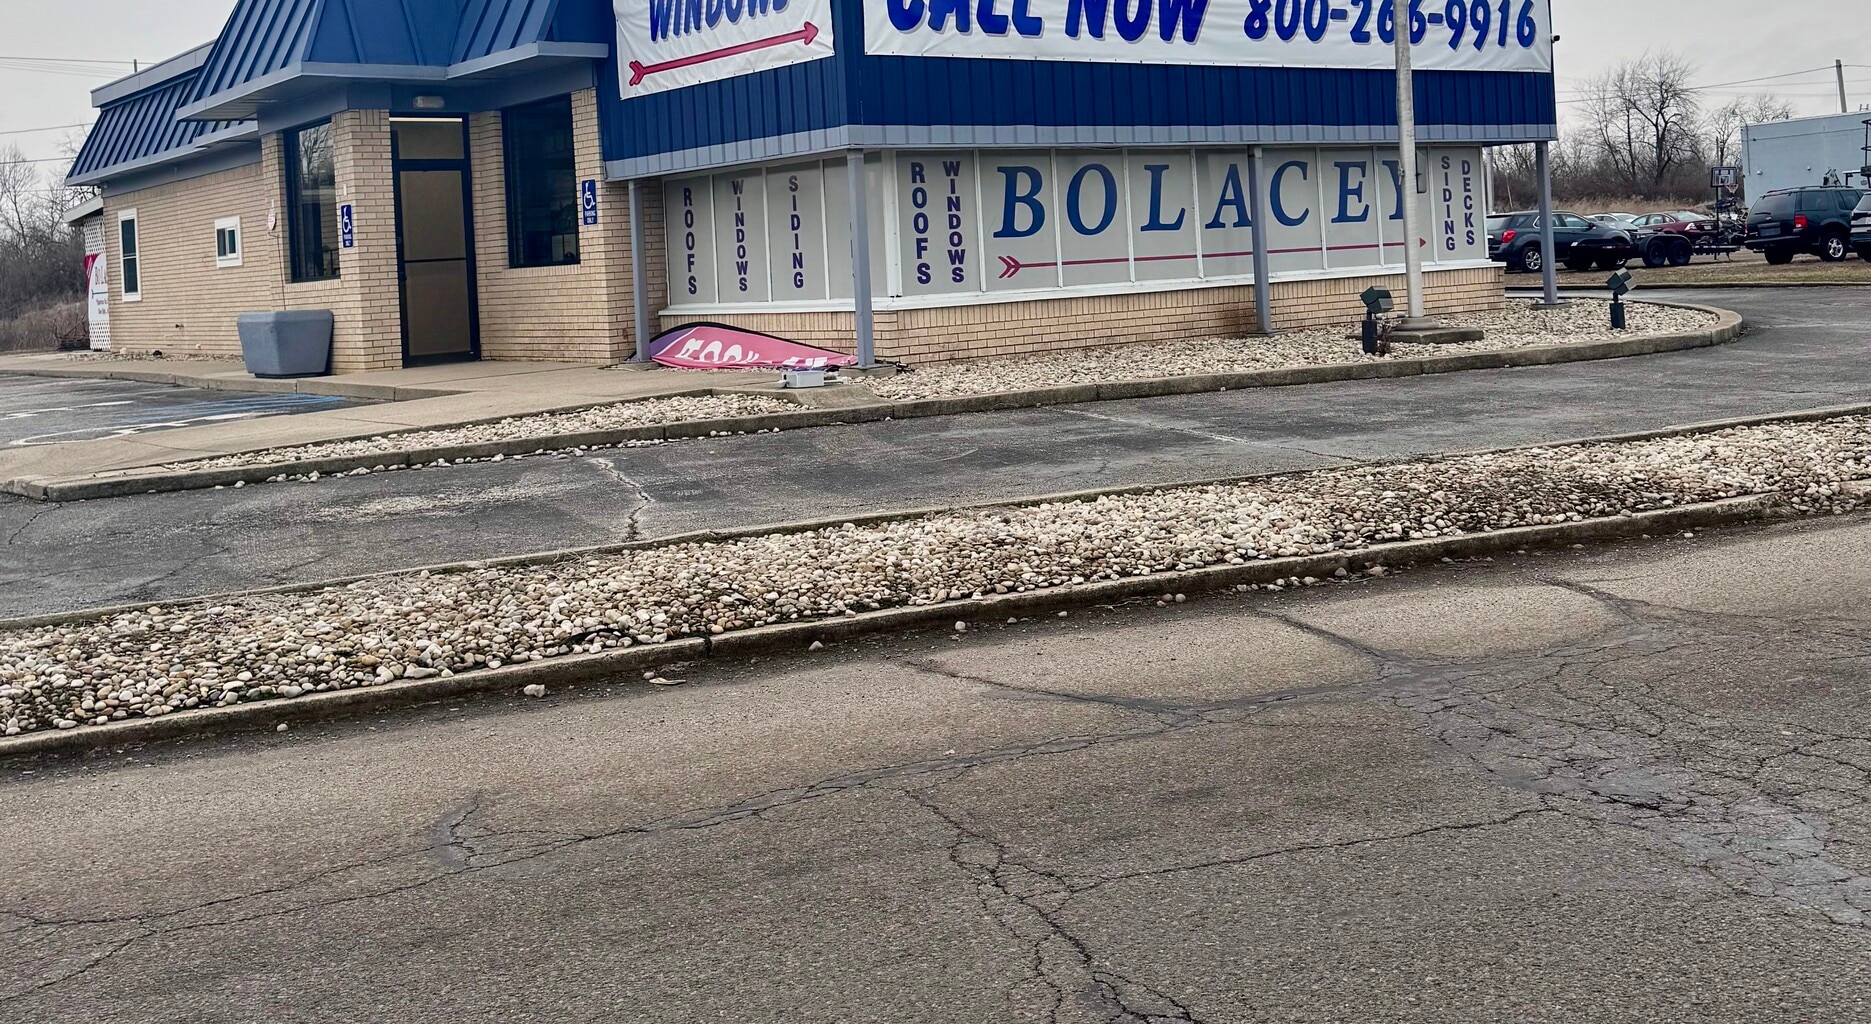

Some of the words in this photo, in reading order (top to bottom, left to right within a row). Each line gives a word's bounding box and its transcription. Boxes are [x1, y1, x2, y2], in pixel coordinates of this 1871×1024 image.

[683, 187, 698, 295] ROOFS
[731, 180, 749, 292] WINDOWS
[788, 175, 804, 289] SIDING
[910, 162, 932, 285] ROOFS
[943, 160, 966, 283] WINDOWS
[1441, 155, 1456, 251] SIDING
[1461, 159, 1475, 246] DECKS
